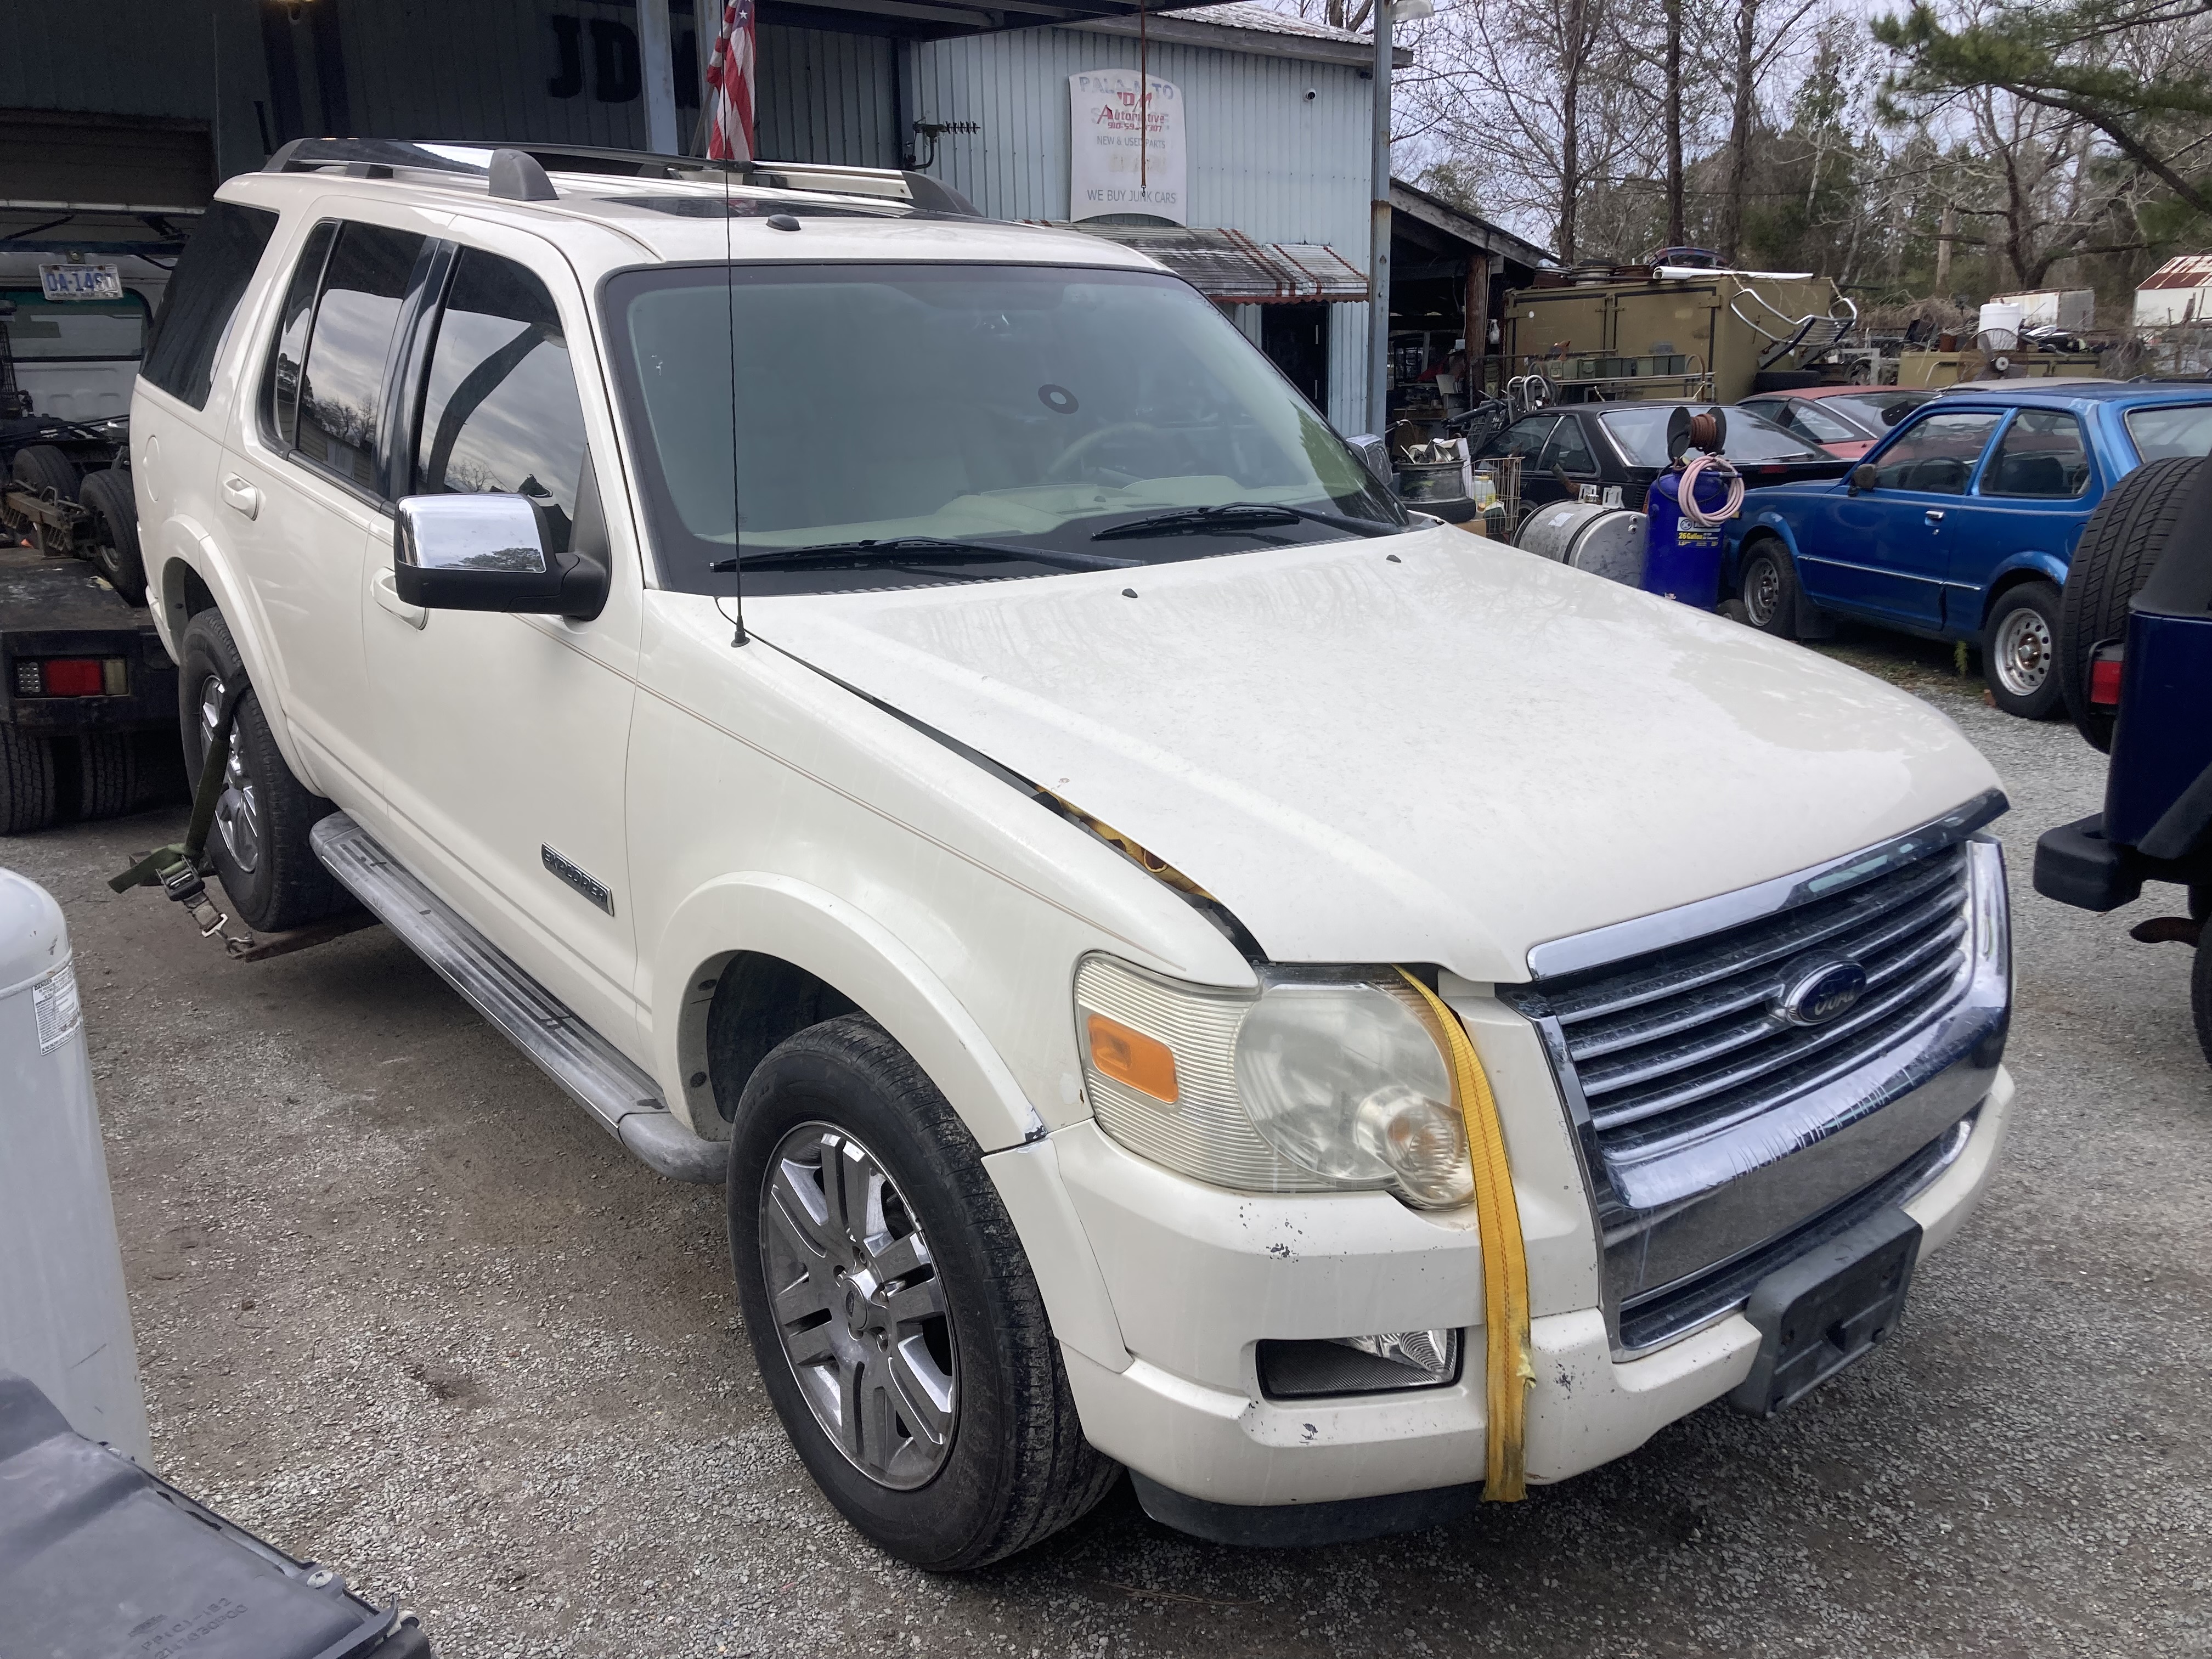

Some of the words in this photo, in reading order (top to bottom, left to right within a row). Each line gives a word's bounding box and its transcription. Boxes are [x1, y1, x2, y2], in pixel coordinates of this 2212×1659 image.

[1097, 105, 1164, 124] Automtive
[1097, 136, 1115, 145] NEW
[1117, 137, 1122, 145] &
[1146, 139, 1166, 149] PARTS
[1087, 189, 1103, 200] WE
[1107, 190, 1126, 201] BUY
[1128, 190, 1152, 202] JUNK
[1155, 192, 1176, 204] CARS
[544, 848, 607, 902] EXPLORER
